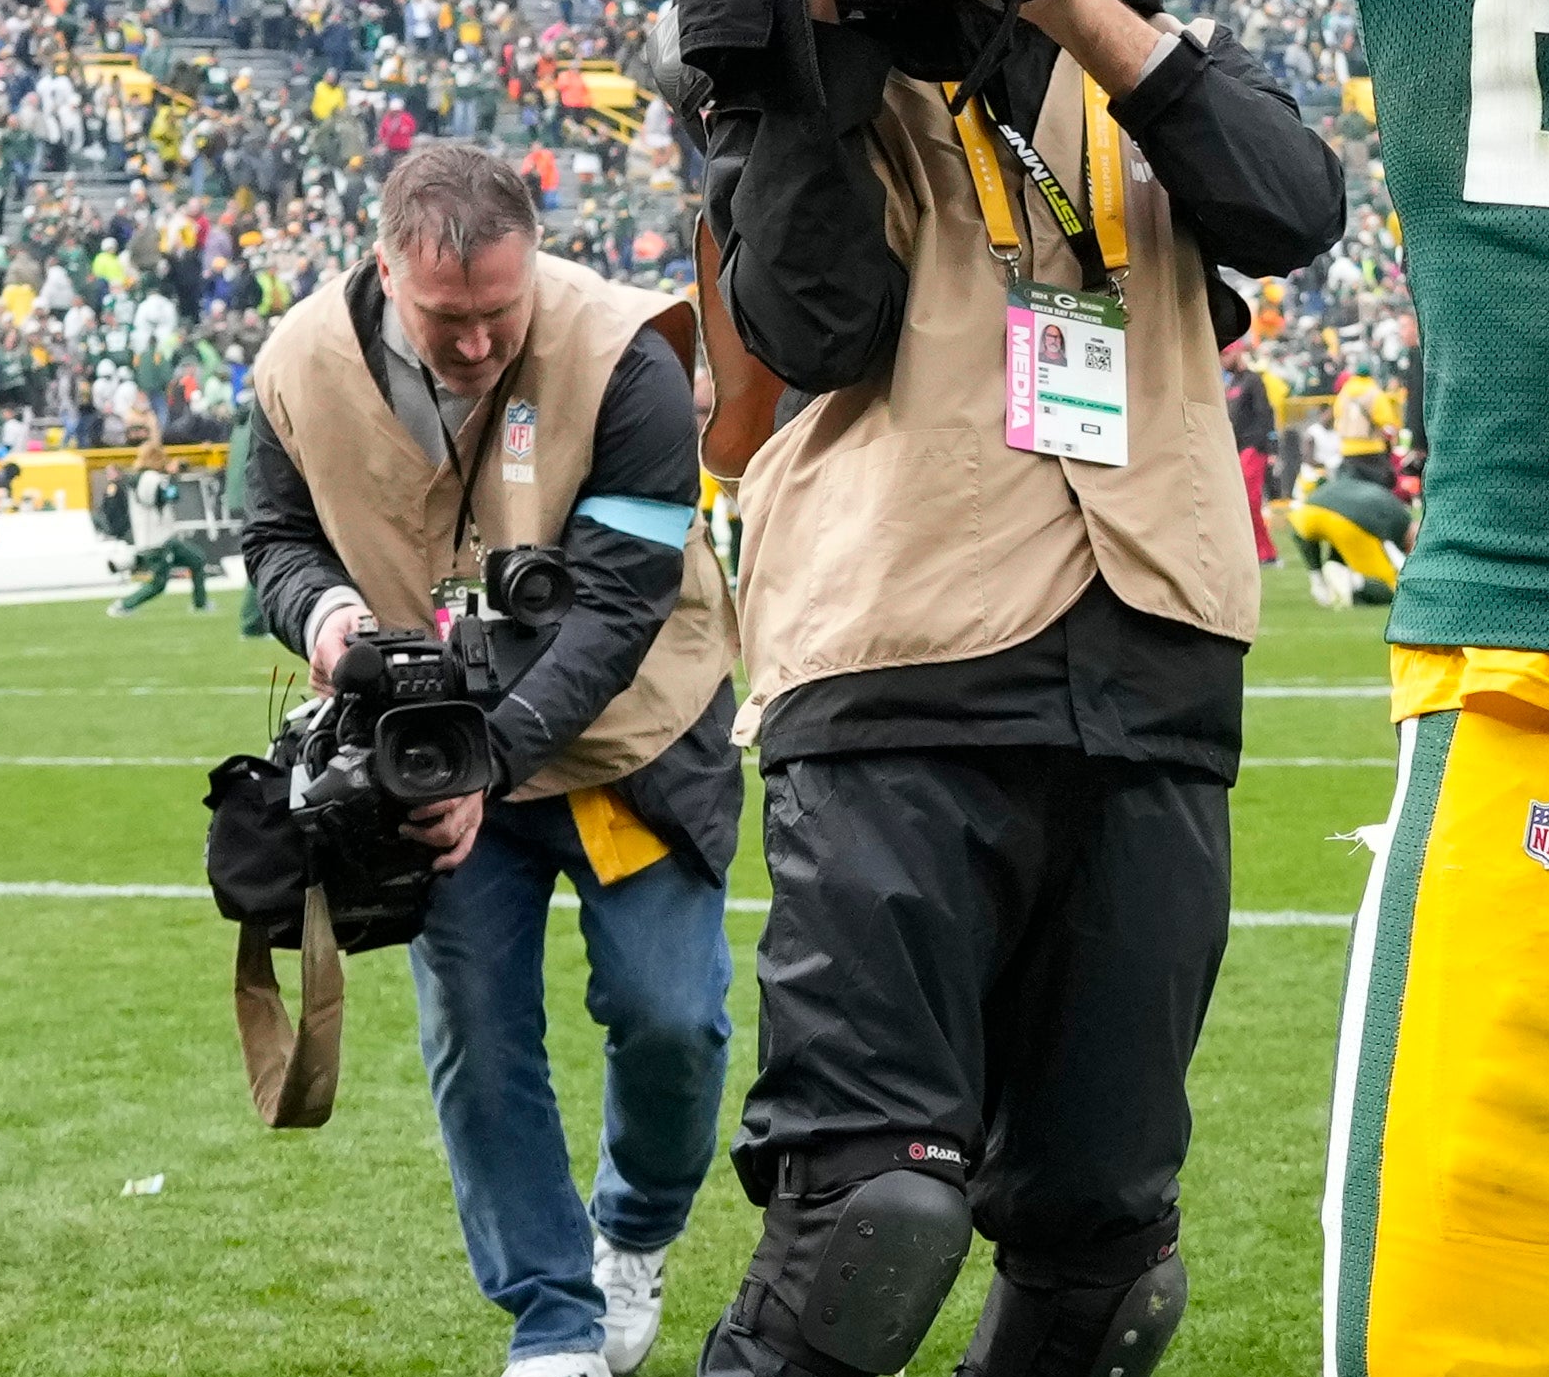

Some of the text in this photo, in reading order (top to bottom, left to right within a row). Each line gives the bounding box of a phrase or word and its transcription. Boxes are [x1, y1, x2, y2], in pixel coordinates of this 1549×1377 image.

[998, 124, 1084, 237] ESPN MNF
[1011, 325, 1031, 430] MEDIA
[508, 423, 533, 450] NFL
